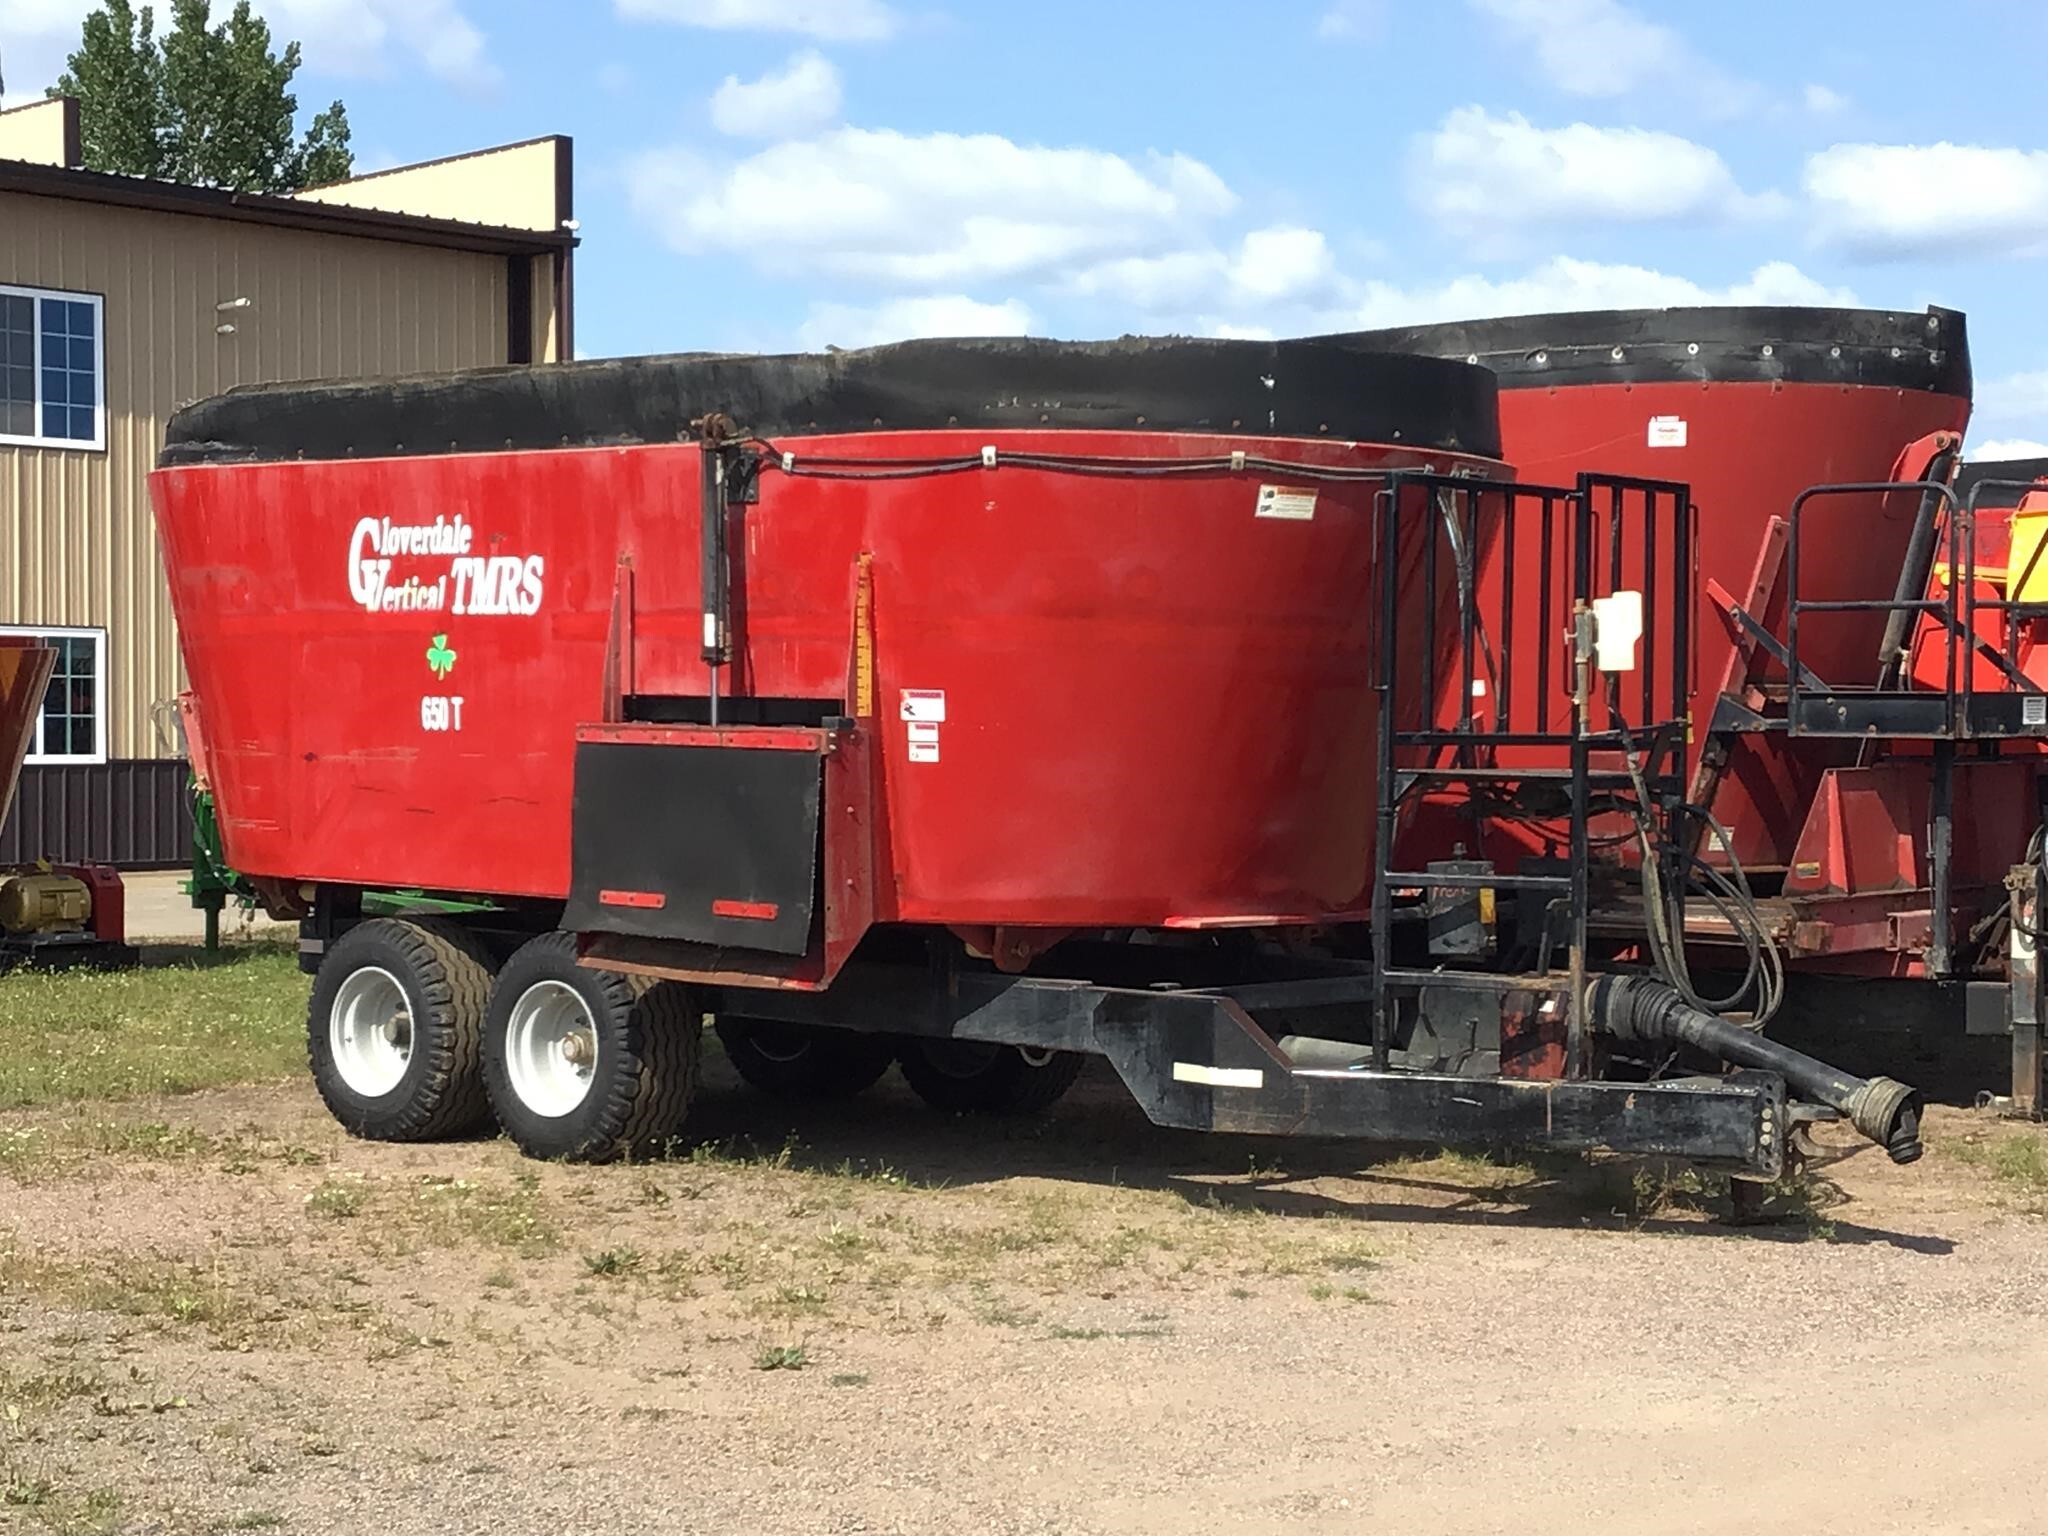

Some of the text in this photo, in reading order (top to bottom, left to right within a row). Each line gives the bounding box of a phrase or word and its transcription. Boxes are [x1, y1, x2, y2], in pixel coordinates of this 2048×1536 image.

[349, 514, 473, 605] Cloverdale
[360, 555, 544, 616] Vertical TMRS
[421, 696, 464, 731] 650 T
